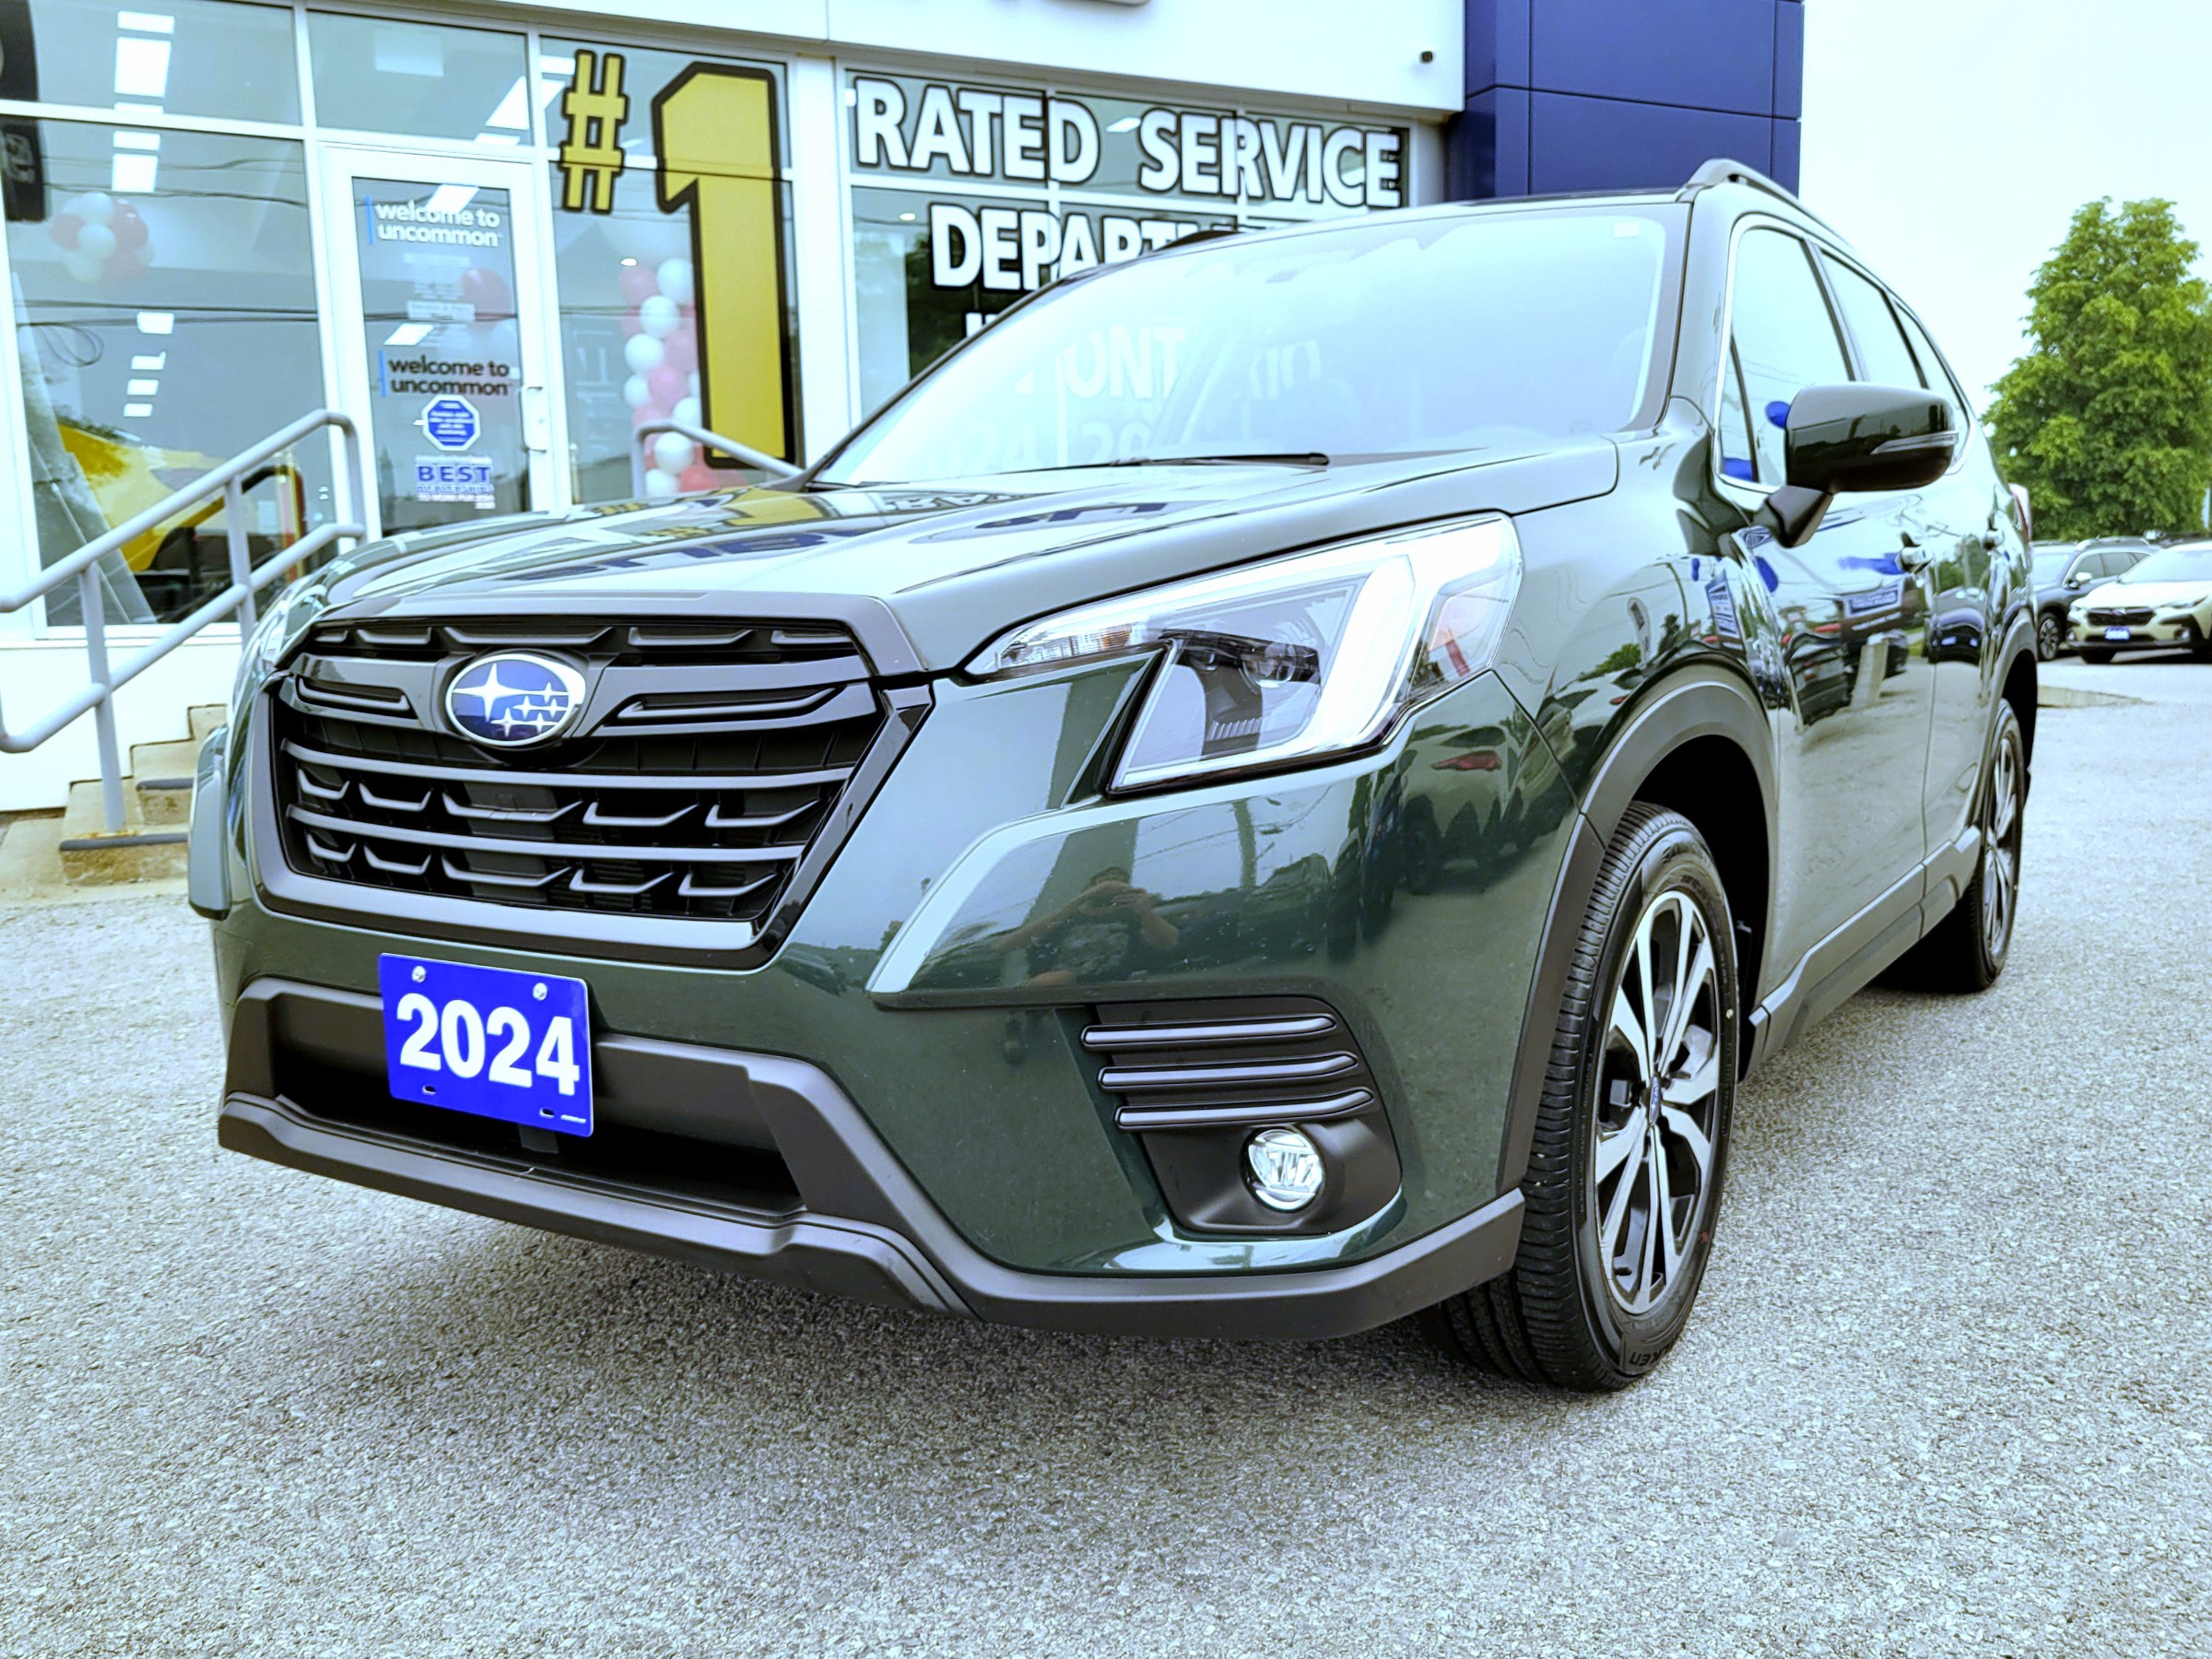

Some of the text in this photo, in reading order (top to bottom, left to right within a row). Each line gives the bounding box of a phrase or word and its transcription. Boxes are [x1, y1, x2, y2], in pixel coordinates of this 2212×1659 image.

[854, 76, 1402, 208] RATED SERVICE
[374, 199, 500, 228] welcome to
[377, 223, 499, 247] uncommon
[388, 354, 510, 377] welcome to
[391, 379, 509, 395] uncommon
[418, 465, 490, 482] BEST
[396, 993, 580, 1096] 2024
